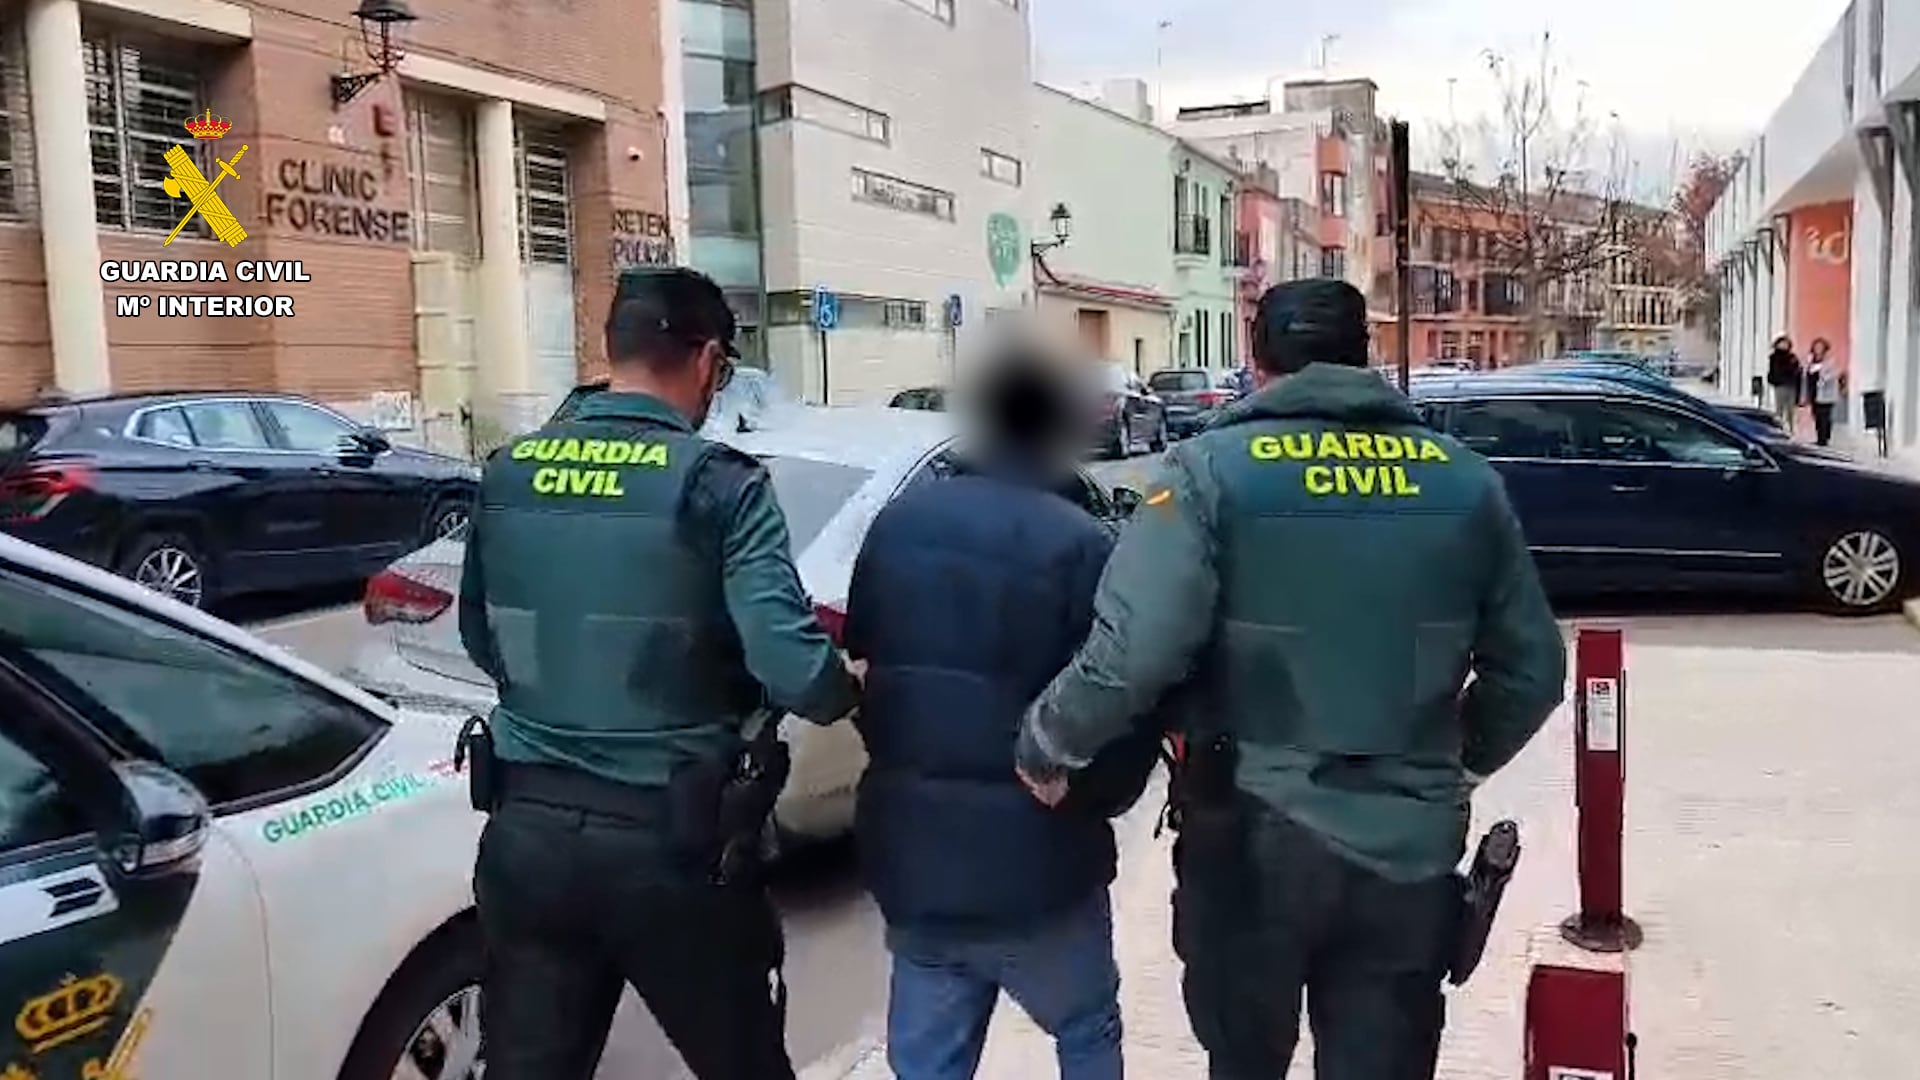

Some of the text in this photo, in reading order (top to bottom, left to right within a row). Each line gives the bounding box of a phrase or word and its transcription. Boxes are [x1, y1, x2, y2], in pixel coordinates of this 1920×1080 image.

[279, 158, 377, 201] CLINIC
[266, 193, 411, 242] FORENSE
[511, 438, 669, 468] GUARDIA
[1250, 431, 1450, 462] GUARDIA
[532, 466, 625, 497] CIVIL
[1304, 464, 1421, 496] CIVIL
[262, 772, 425, 844] GUARDIA CIVIL
